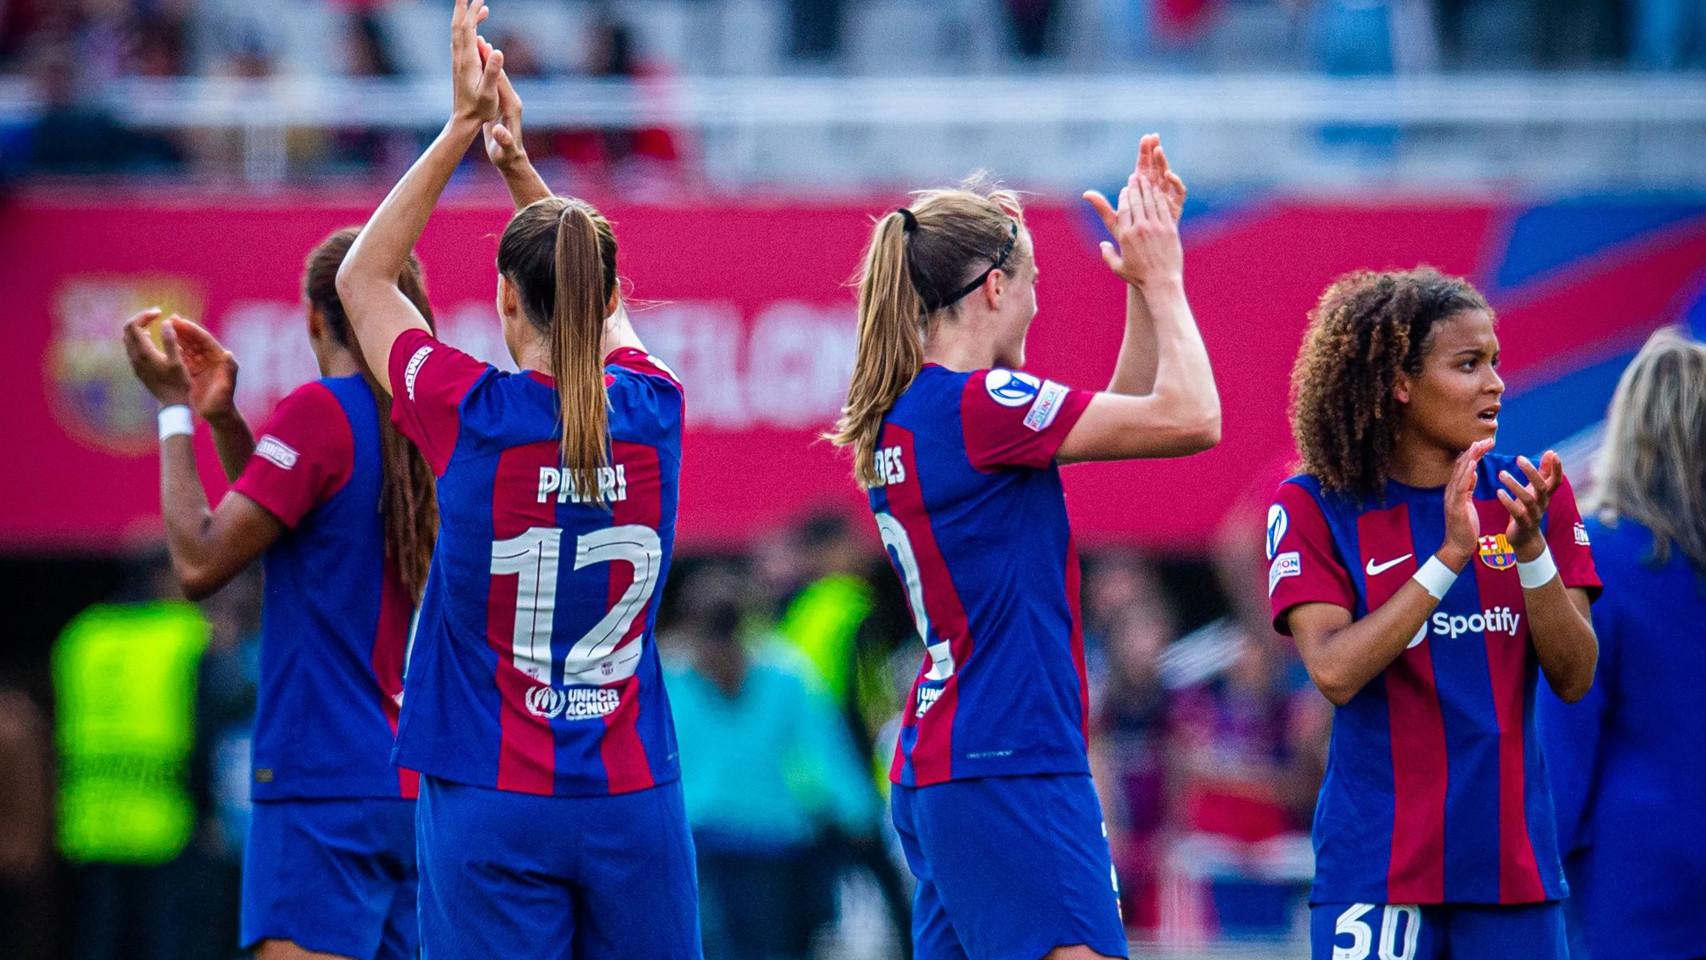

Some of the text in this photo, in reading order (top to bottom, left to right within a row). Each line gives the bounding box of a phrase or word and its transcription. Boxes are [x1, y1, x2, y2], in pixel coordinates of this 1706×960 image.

[537, 464, 627, 503] PARI
[490, 524, 662, 686] 12
[1432, 606, 1520, 639] Spotify
[568, 688, 620, 702] UNHCR
